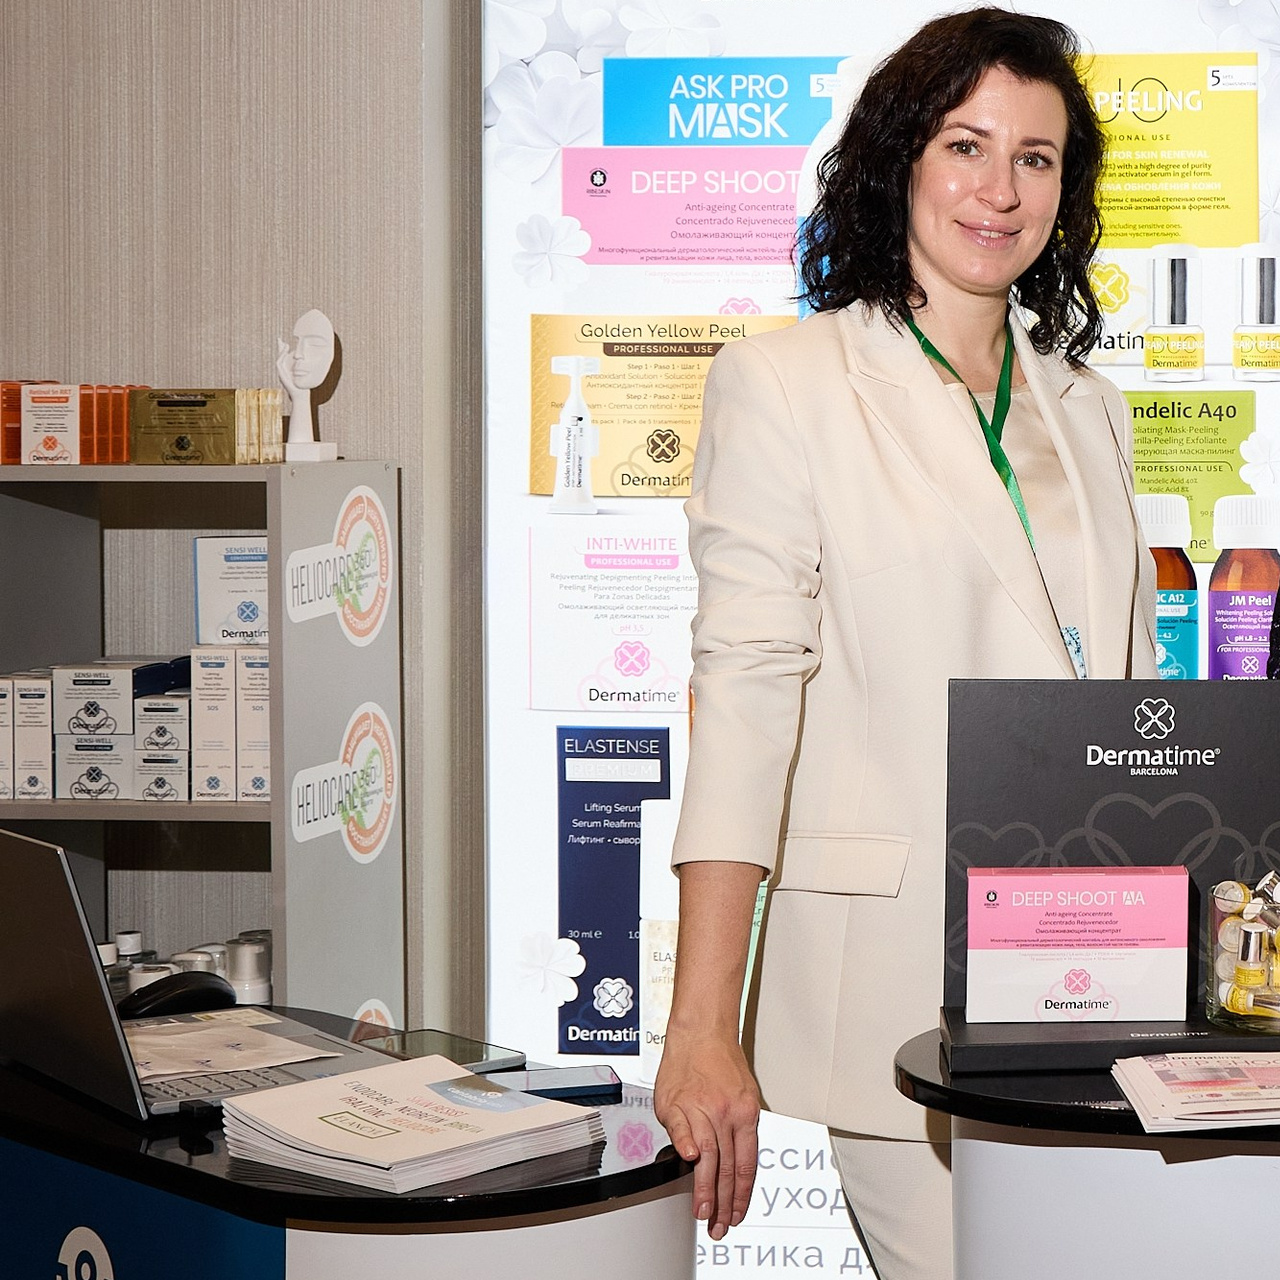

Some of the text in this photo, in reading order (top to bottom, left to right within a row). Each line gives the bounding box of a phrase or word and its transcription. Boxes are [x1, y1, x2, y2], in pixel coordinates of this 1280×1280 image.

[1211, 70, 1221, 86] 5
[669, 74, 788, 99] ASK PRO
[815, 78, 825, 93] 5
[1094, 90, 1203, 112] PEELING
[669, 102, 790, 138] MASK
[1113, 151, 1209, 159] FOR SKIN RENEWAL
[1140, 163, 1155, 171] high
[1156, 163, 1180, 171] degree
[1190, 163, 1212, 171] purity
[631, 170, 800, 194] DEEP SHOOT
[1124, 183, 1189, 191] ОБНОВЛЕНИЯ
[685, 202, 794, 213] Anti-ageing Concentrate
[676, 217, 734, 226] Concentrado
[670, 231, 753, 240] Омолаживающий
[580, 323, 747, 338] Golden Yellow Peel
[614, 344, 714, 354] PROFESSIONAL USE
[627, 363, 695, 371] Step Paso Шаг
[626, 393, 695, 401] Step Paso Шаг
[1198, 403, 1237, 421] A40
[1165, 426, 1219, 435] Mask-Peeling
[586, 537, 677, 551] INTI-WHITE
[591, 558, 672, 566] PROFESSIONAL USE
[291, 554, 353, 607] HELIOCARE
[550, 573, 651, 582] Rejuvenating Depigmenting
[588, 584, 642, 593] Rejuvenecedor
[1169, 594, 1184, 603] A12
[1230, 595, 1272, 606] JM Peel
[564, 739, 659, 754] ELASTENSE
[1130, 768, 1179, 776] BARCELONA
[297, 771, 358, 826] HELIOCARE
[584, 803, 612, 814] Lifting
[572, 819, 602, 829] Serum
[567, 835, 605, 845] Лифтинг
[1012, 891, 1117, 906] DEEP SHOOT
